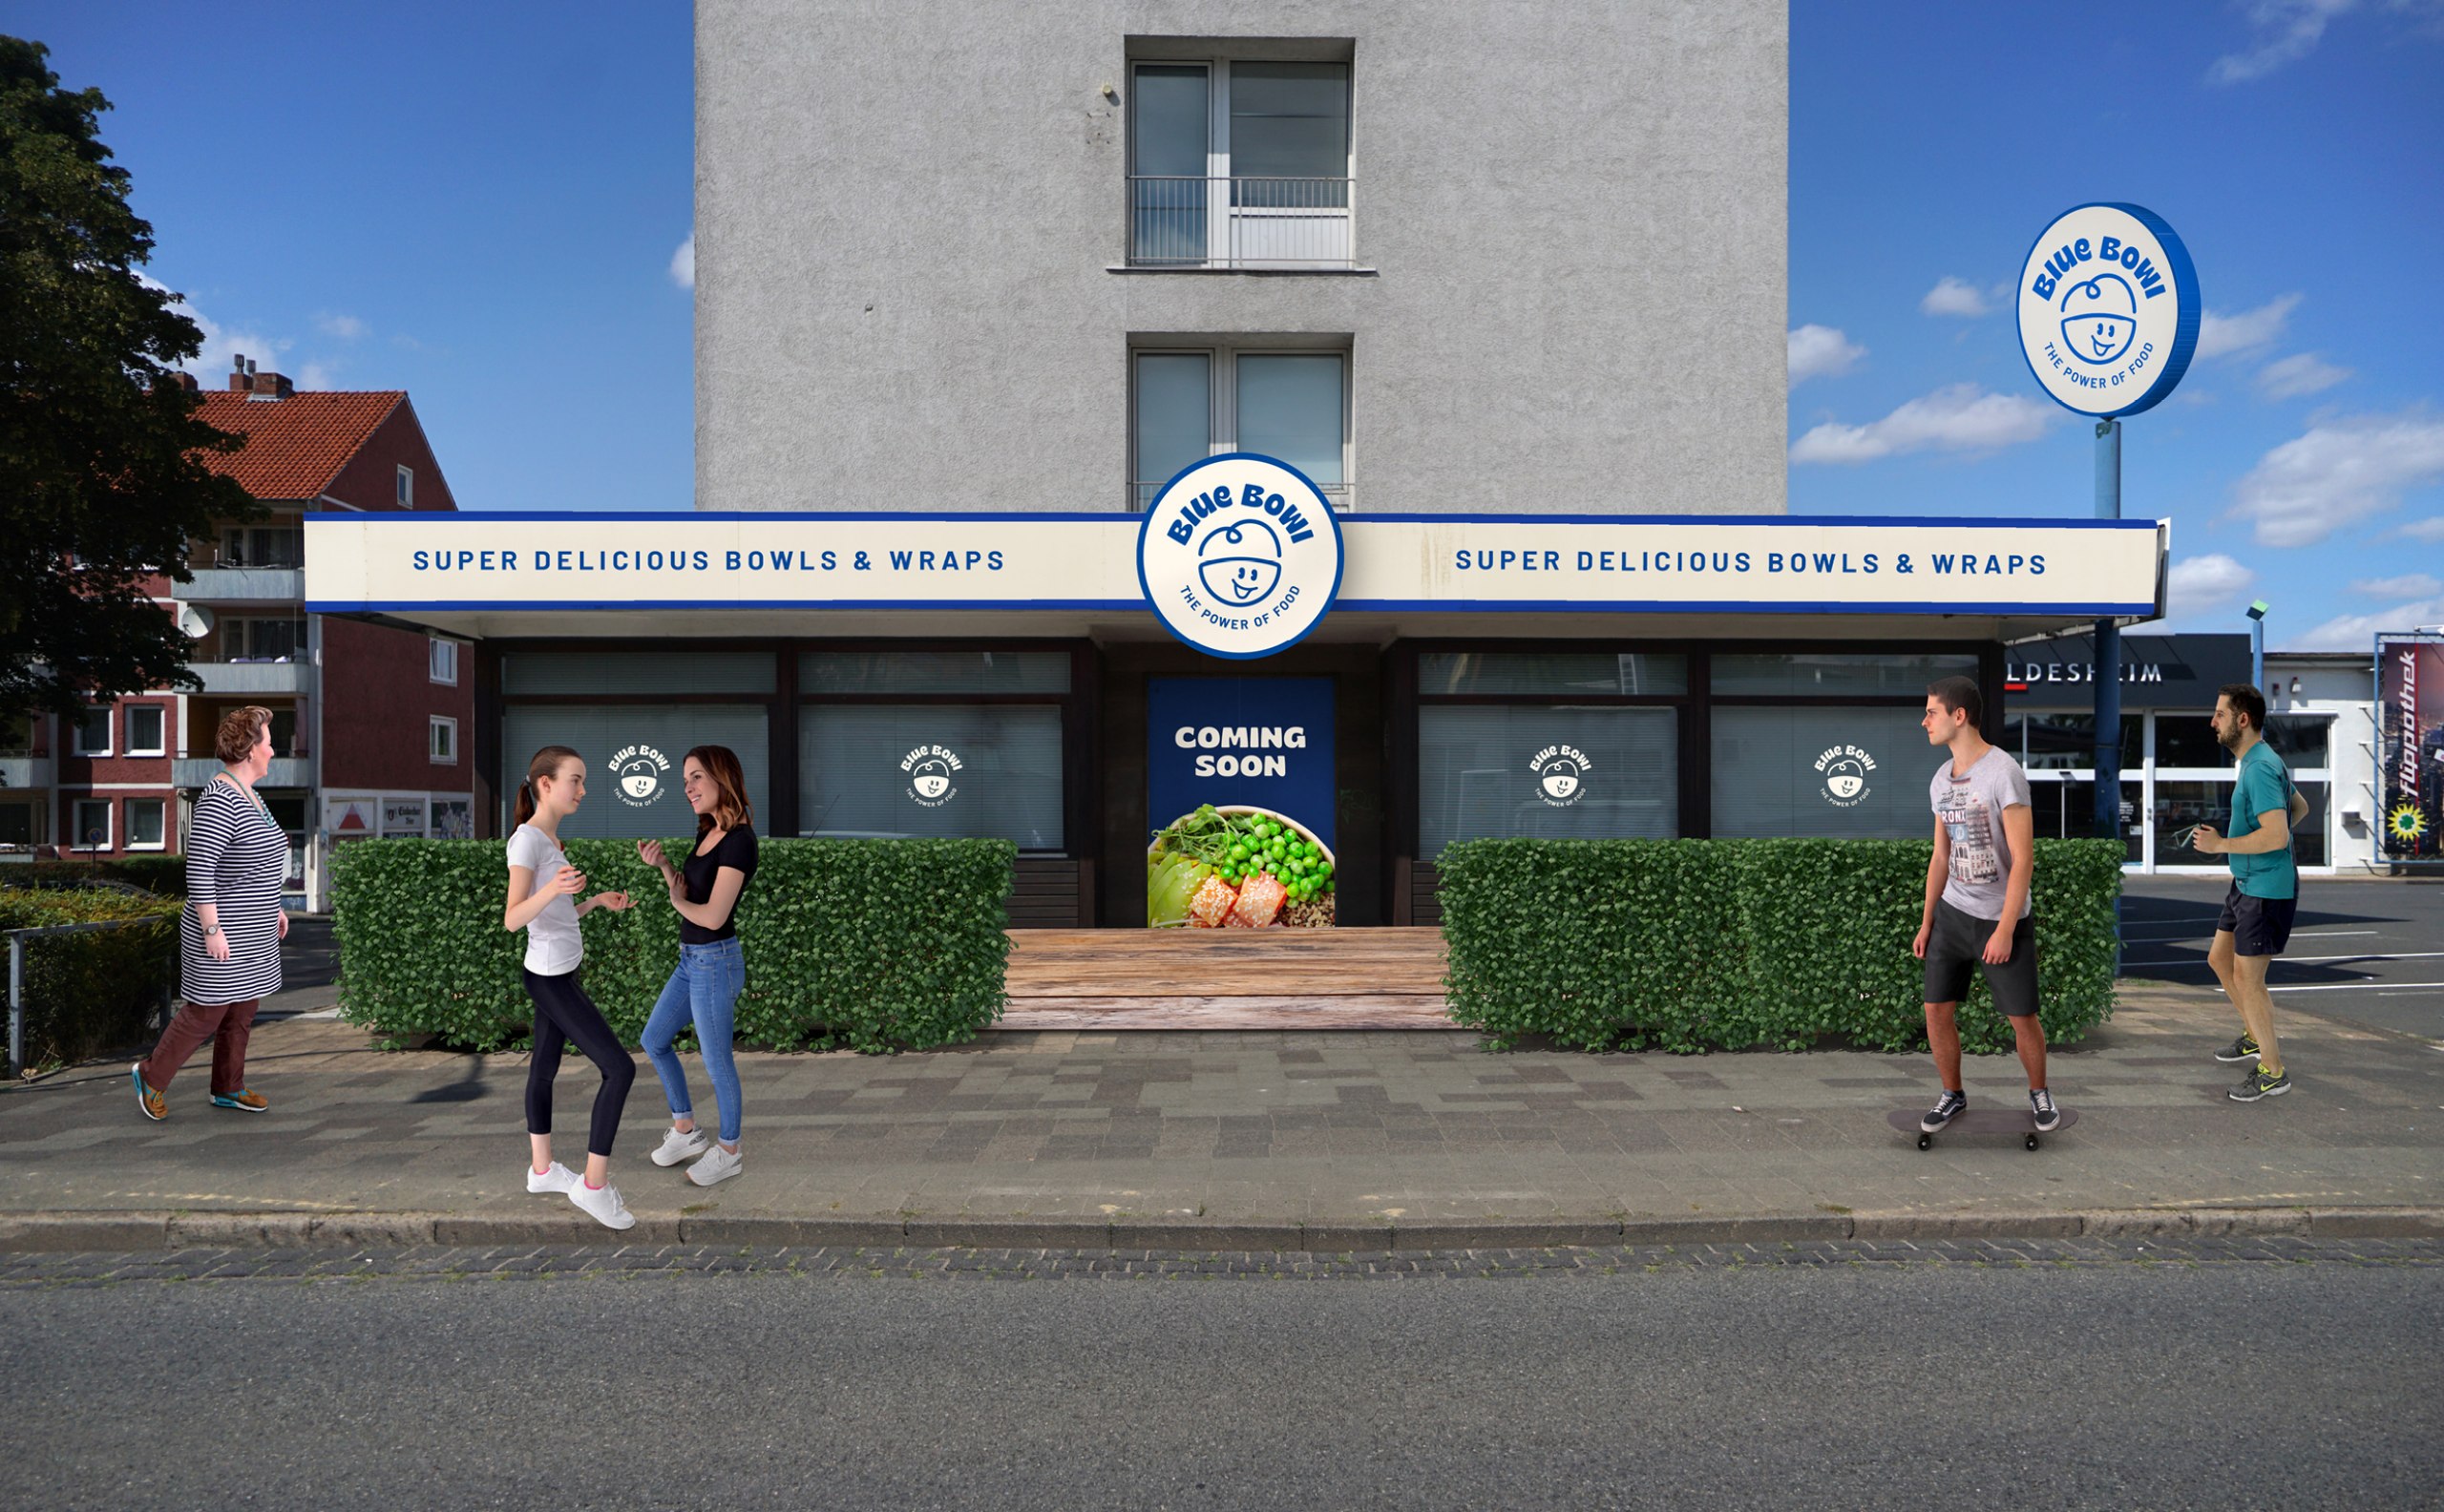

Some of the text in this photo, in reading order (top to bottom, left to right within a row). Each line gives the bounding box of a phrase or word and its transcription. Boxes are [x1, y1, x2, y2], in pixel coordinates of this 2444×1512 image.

[2032, 238, 2093, 302] Blue
[2044, 342, 2154, 388] THE POWER OF FOOD
[1167, 485, 1233, 546] Blue
[412, 550, 1003, 571] SUPER DELICIOUS BOWLS & WRAPS
[1455, 549, 2046, 576] SUPER DELICIOUS BOWLS & WRAPS
[1180, 584, 1300, 630] THE POWER OF FOOD
[2398, 650, 2419, 797] flippothek
[1174, 725, 1307, 748] COMING
[1194, 754, 1286, 777] SOON
[614, 788, 622, 799] THE
[622, 798, 643, 807] POWER
[653, 788, 664, 801] FOOD
[906, 788, 915, 799] THE
[915, 798, 936, 807] POWER
[945, 788, 957, 801] FOOD
[1535, 788, 1544, 799] THE
[1544, 798, 1564, 807] POWER
[1574, 788, 1586, 801] FOOD
[1820, 788, 1829, 799] THE
[1828, 798, 1849, 807] POWER
[1859, 788, 1871, 801] FOOD
